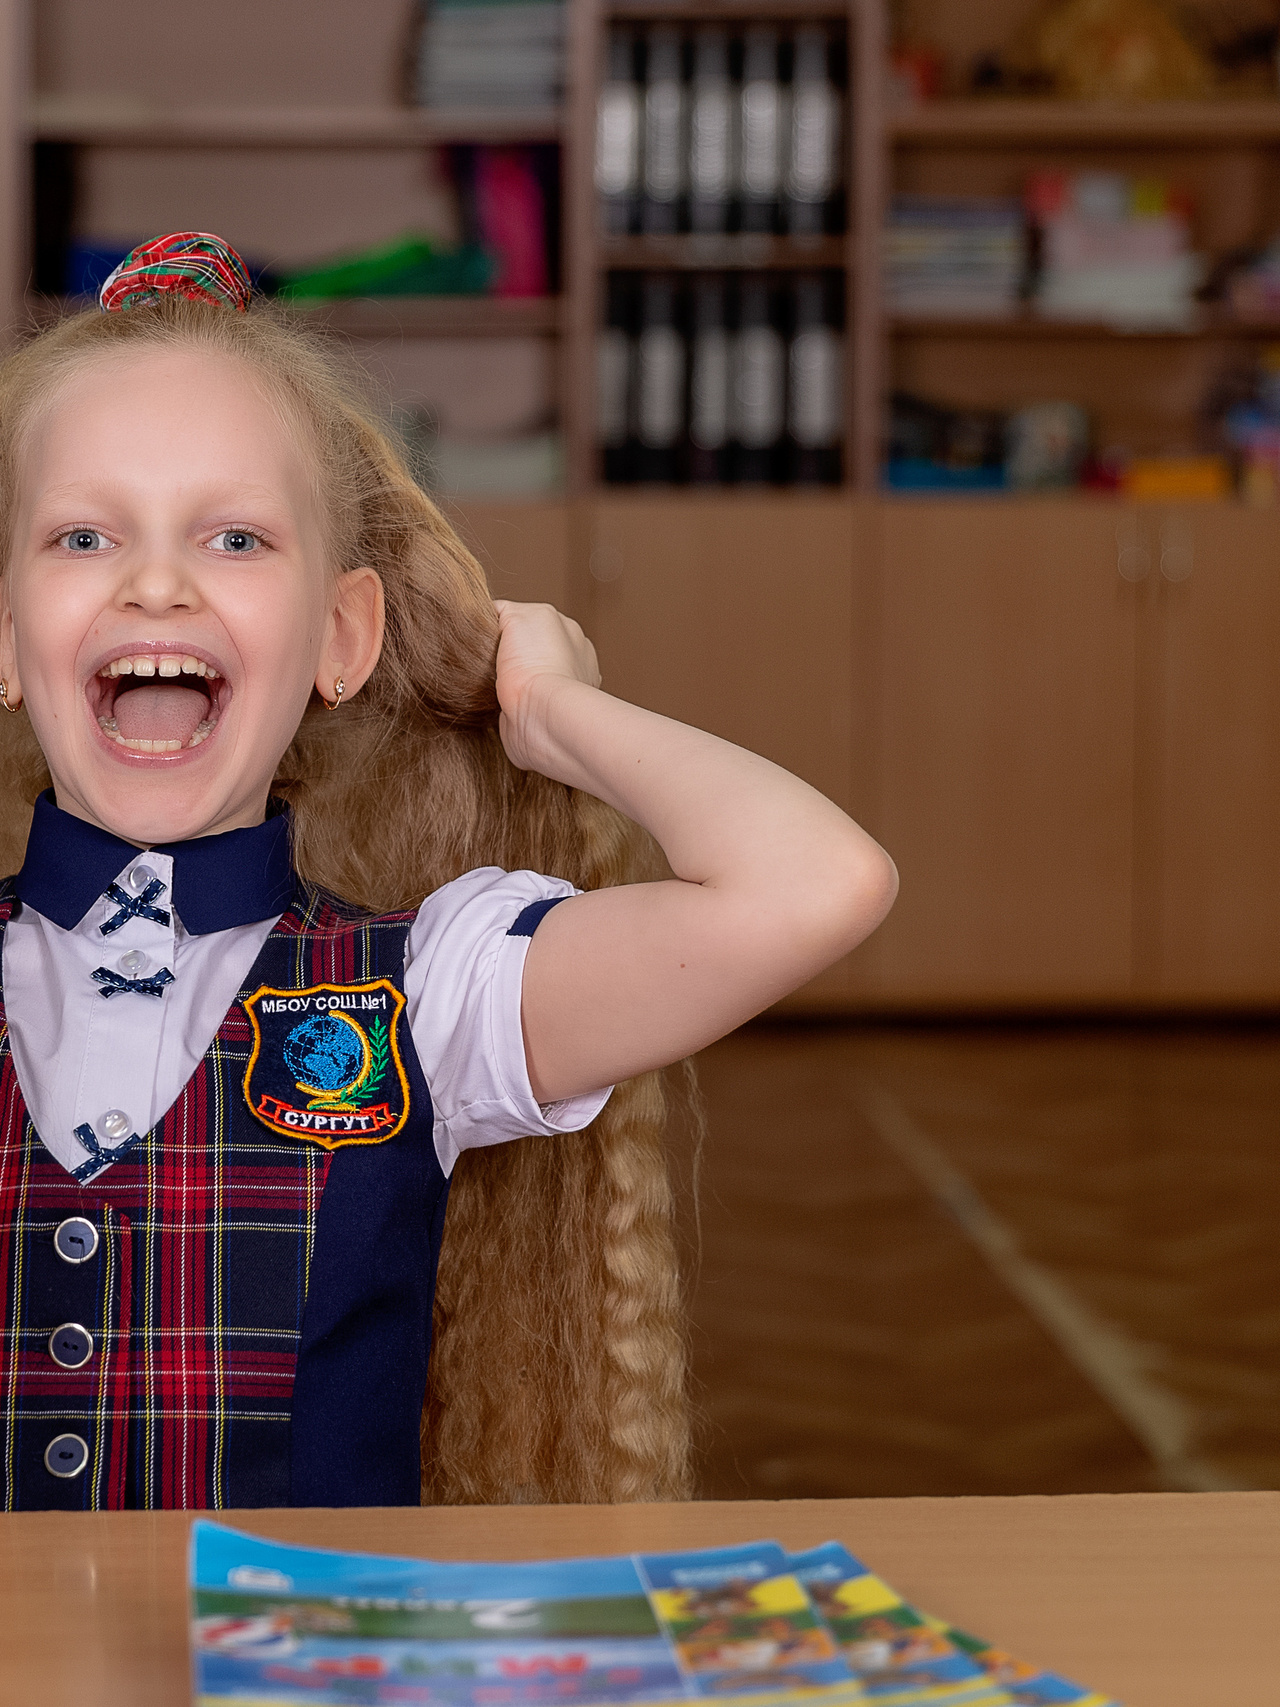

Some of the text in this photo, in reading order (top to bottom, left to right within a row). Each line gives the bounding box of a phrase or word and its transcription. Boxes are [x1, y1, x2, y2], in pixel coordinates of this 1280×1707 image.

[261, 993, 387, 1014] МБОУ СОШ №1
[284, 1111, 370, 1131] СУРГУТ
